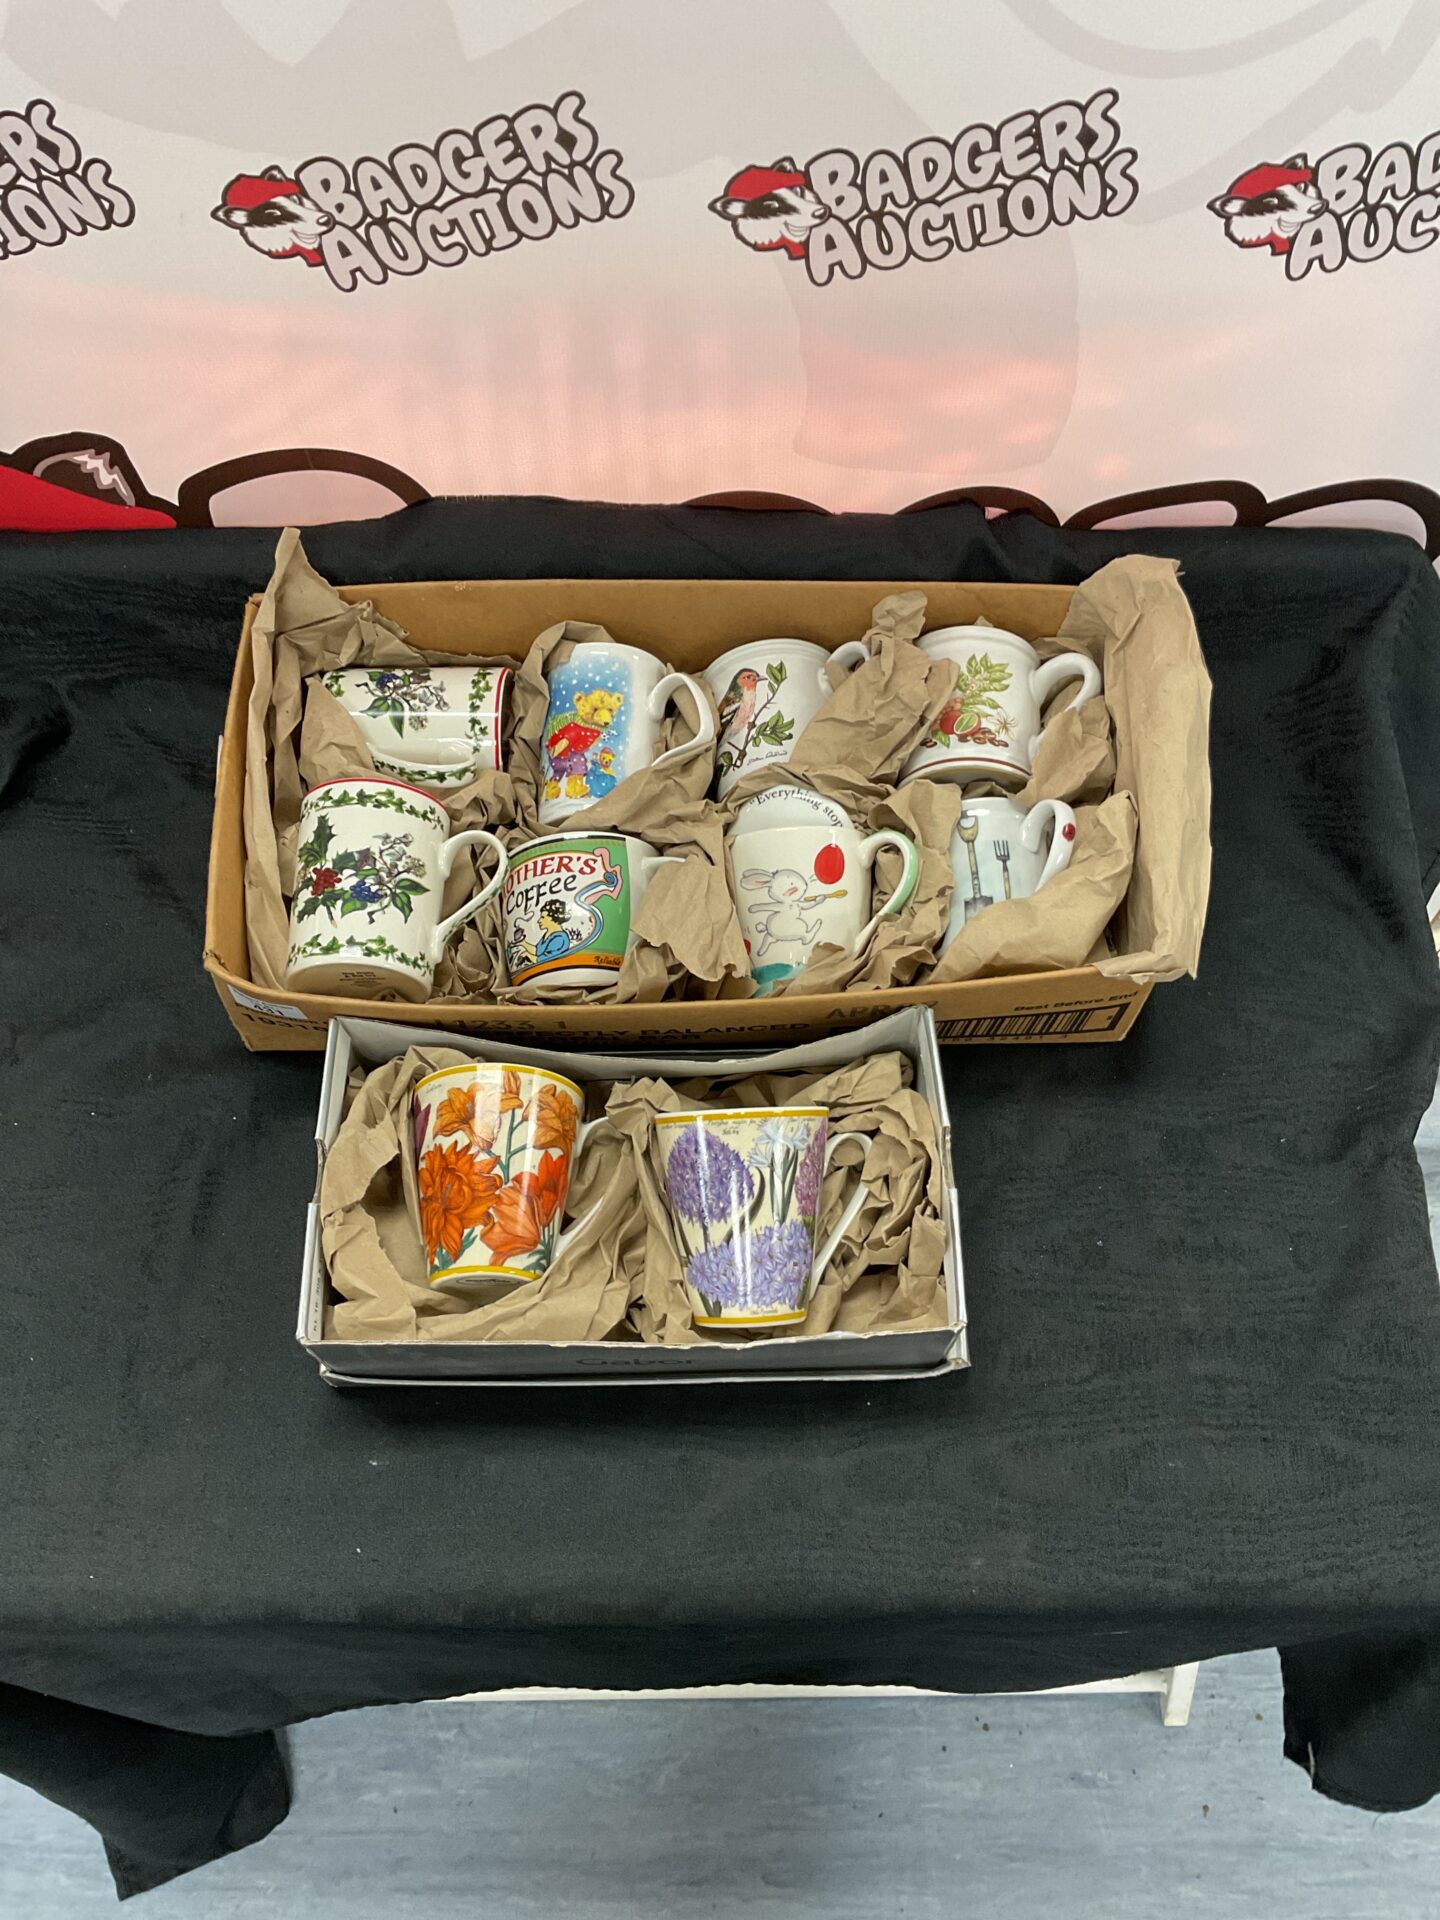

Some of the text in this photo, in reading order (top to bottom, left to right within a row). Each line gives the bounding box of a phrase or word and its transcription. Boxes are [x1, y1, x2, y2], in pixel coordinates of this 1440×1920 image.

[0, 98, 82, 184] RS
[297, 90, 598, 231] BADGERS
[806, 87, 1119, 224] BADGERS
[322, 149, 635, 292] AUCTIONS
[804, 147, 1139, 287] AUCTIONS
[505, 855, 598, 895] OTHER'S
[641, 1023, 811, 1036] BALANCED
[1014, 990, 1139, 1012] Best Before End
